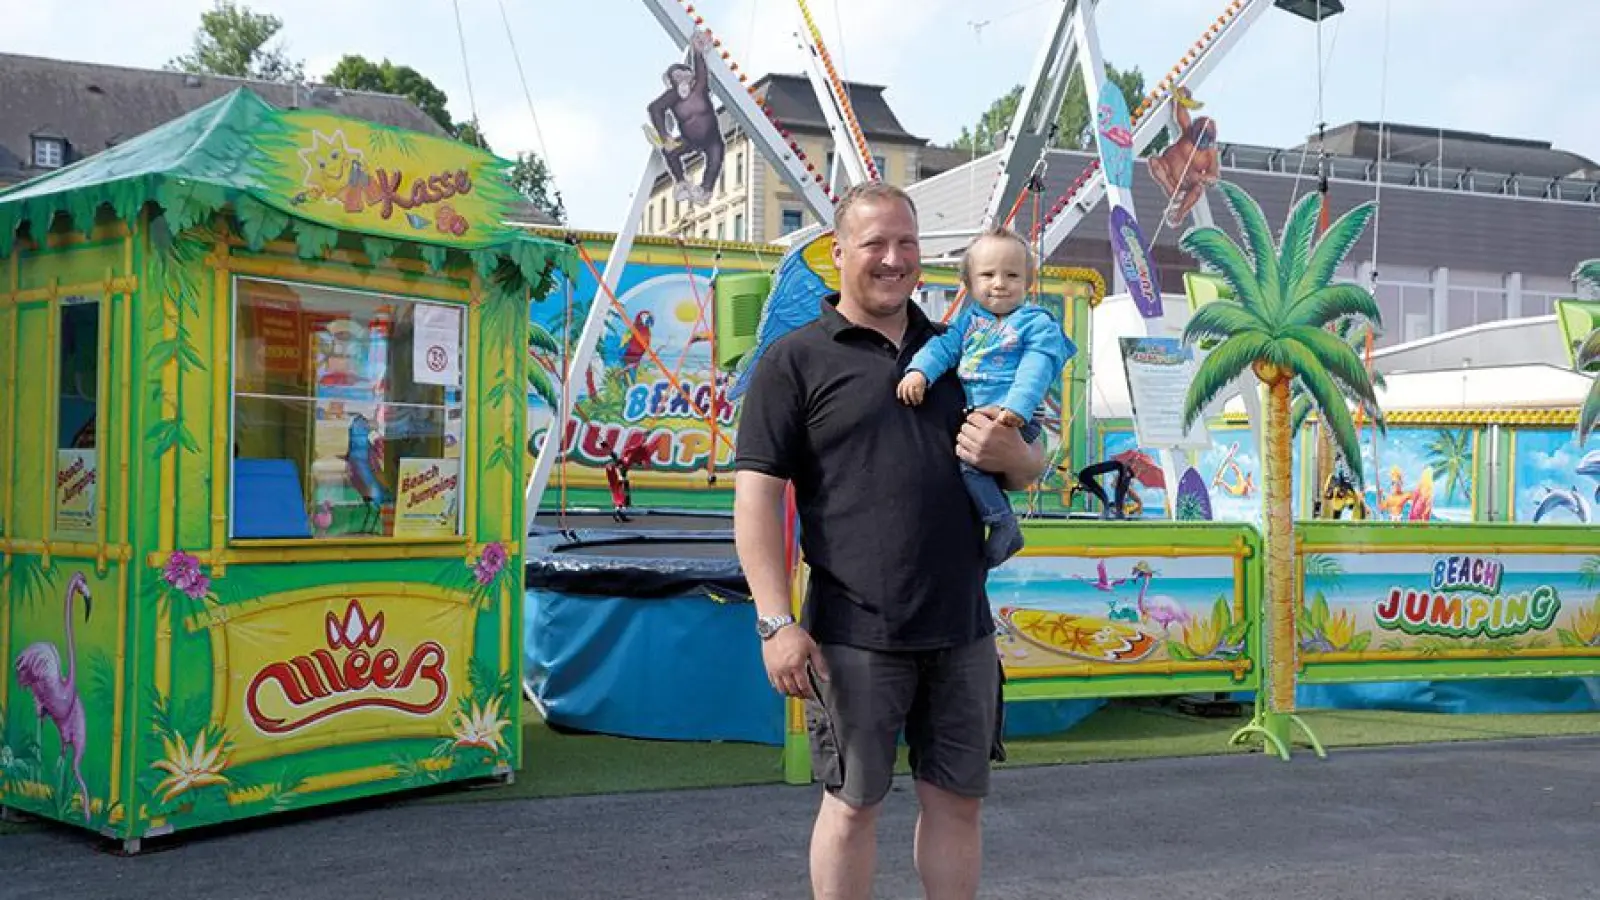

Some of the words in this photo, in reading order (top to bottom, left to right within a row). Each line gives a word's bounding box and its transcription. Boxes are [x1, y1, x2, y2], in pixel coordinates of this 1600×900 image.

[375, 166, 472, 219] Kasse
[624, 380, 735, 422] BEACH
[57, 456, 84, 488] Beach
[401, 463, 440, 493] Beach
[406, 474, 458, 509] Jumping
[1432, 555, 1501, 592] BEACH
[1375, 586, 1556, 631] JUMPING
